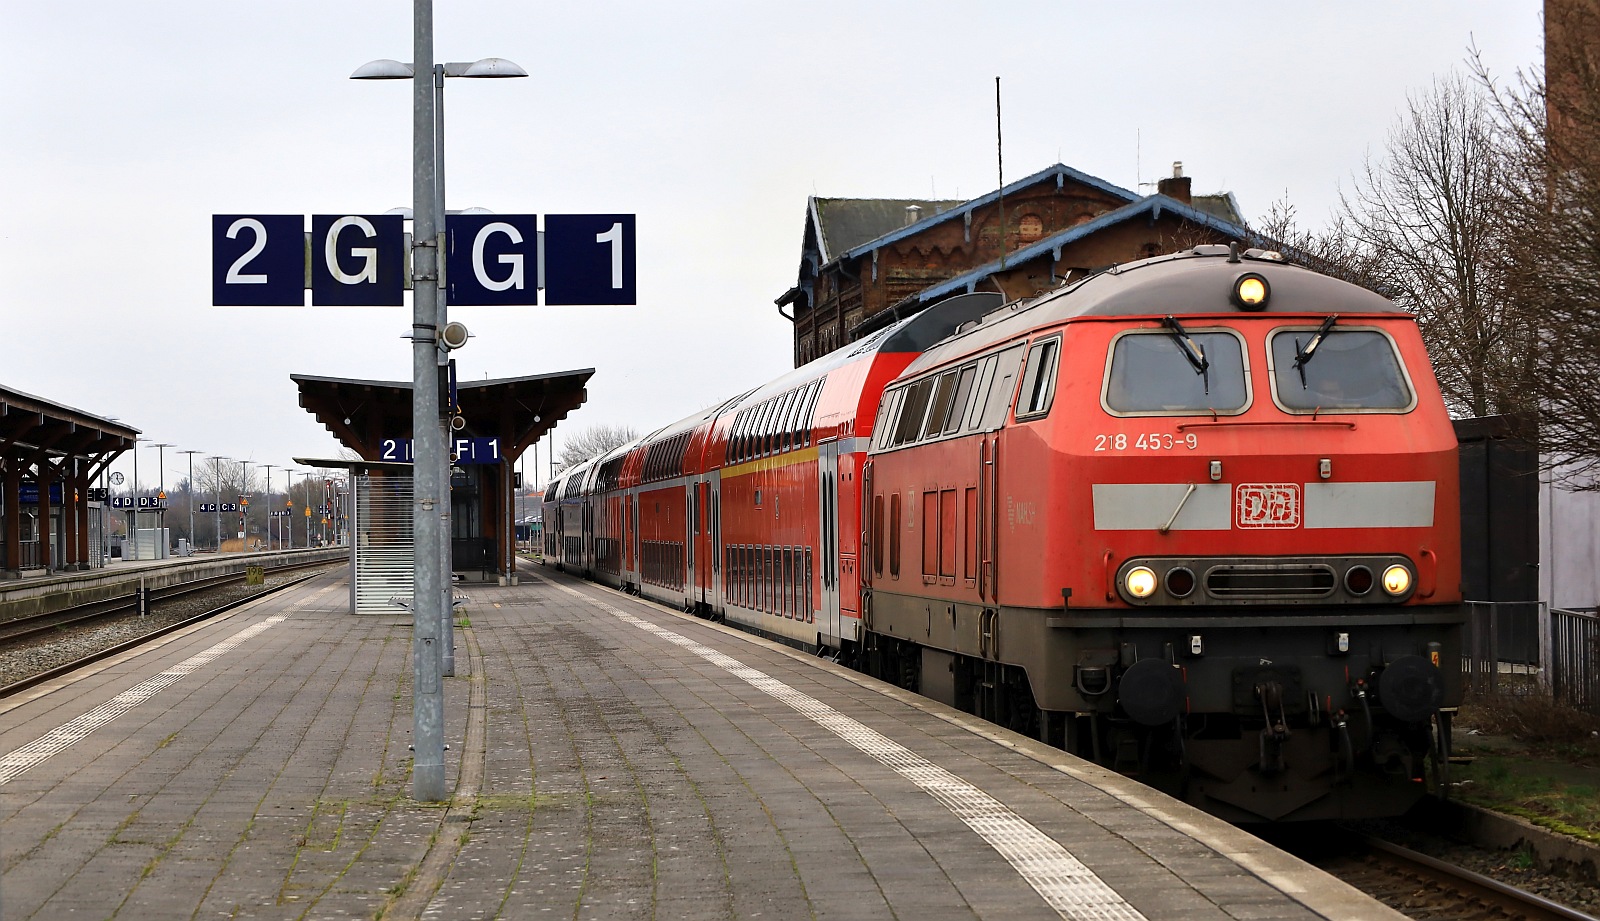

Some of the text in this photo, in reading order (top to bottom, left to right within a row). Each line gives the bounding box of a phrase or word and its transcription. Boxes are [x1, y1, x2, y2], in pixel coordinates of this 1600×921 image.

[225, 215, 623, 291] 2 G G 1
[383, 439, 498, 460] 2 F 1
[1094, 433, 1198, 451] 218 453-9
[100, 488, 107, 499] 3
[113, 497, 158, 506] 4 D D 3
[200, 503, 236, 511] 4 C C 3
[1243, 491, 1292, 521] DB
